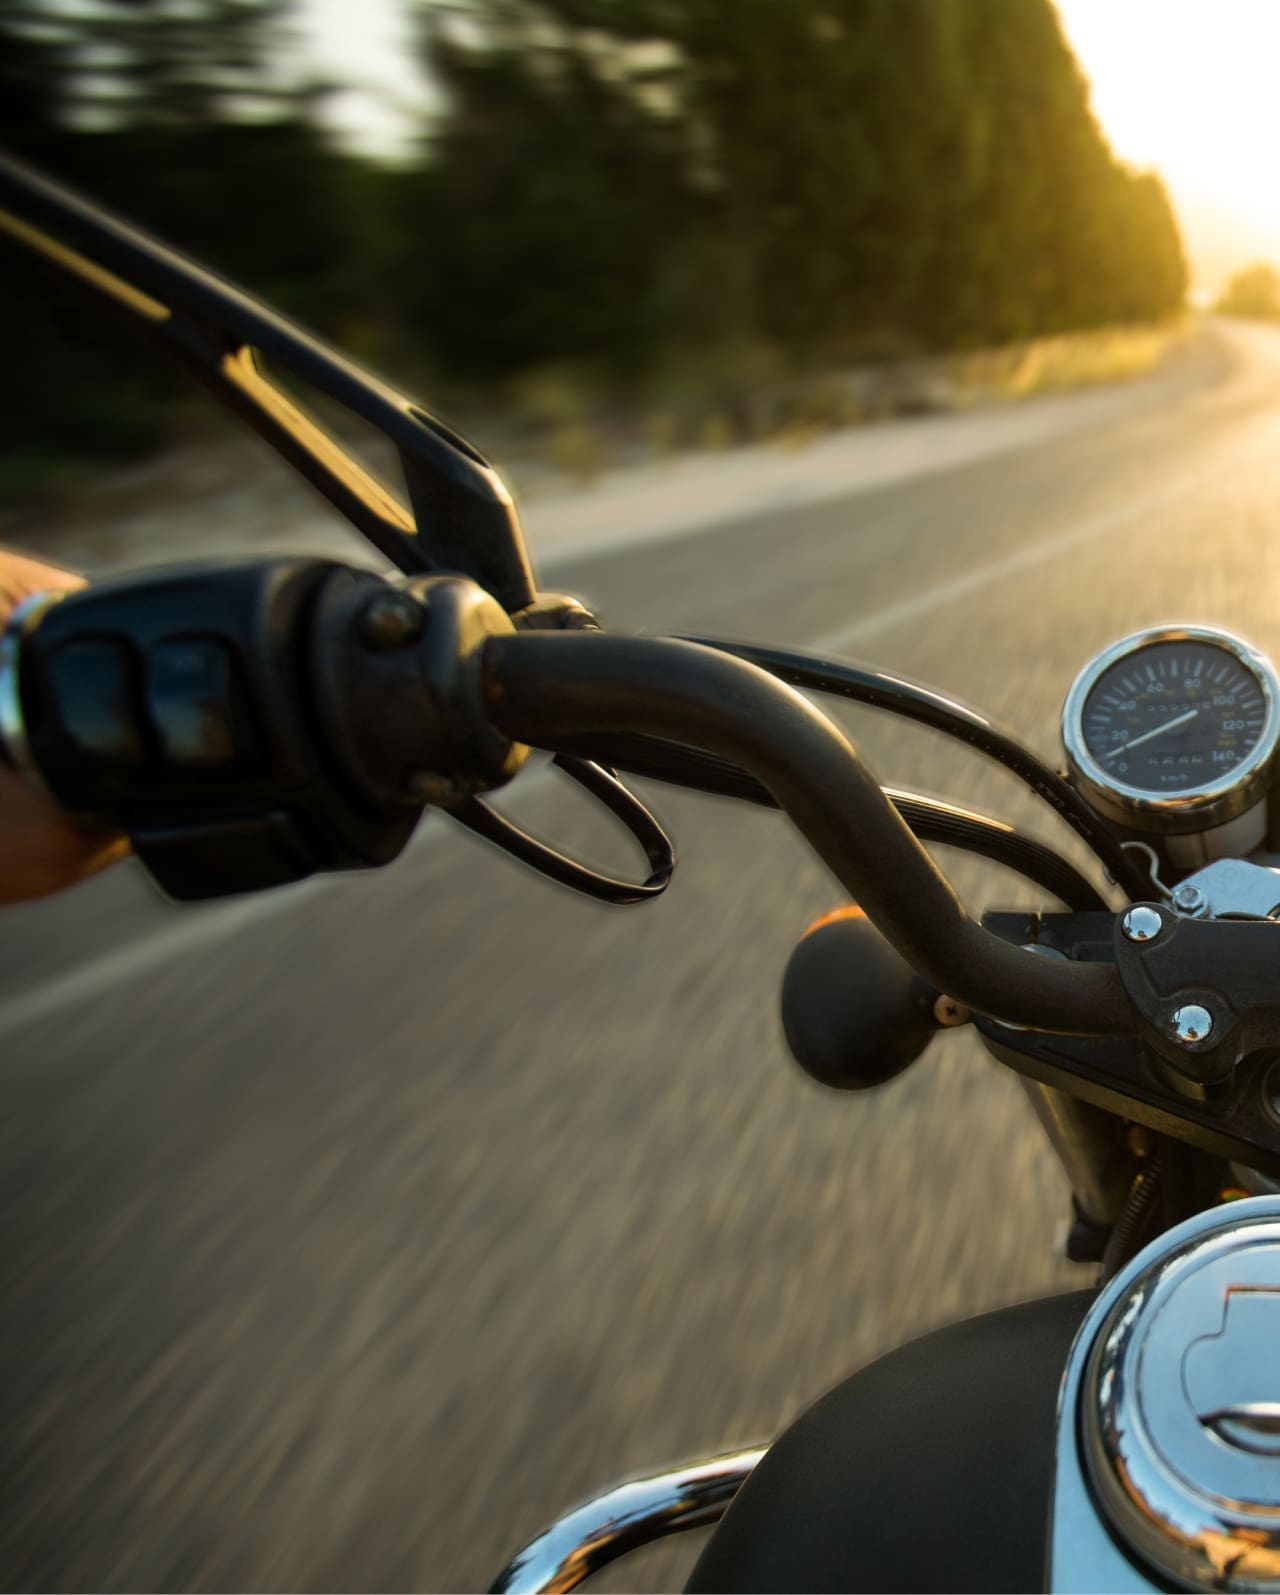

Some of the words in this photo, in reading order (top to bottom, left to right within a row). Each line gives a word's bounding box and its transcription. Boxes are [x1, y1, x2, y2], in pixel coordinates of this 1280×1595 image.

[1146, 682, 1166, 693] 60
[1184, 678, 1201, 688] 80
[1213, 695, 1235, 706] 100
[1222, 719, 1245, 731] 120
[1111, 730, 1128, 740] 20
[1212, 751, 1235, 762] 140
[1118, 762, 1128, 772] 0
